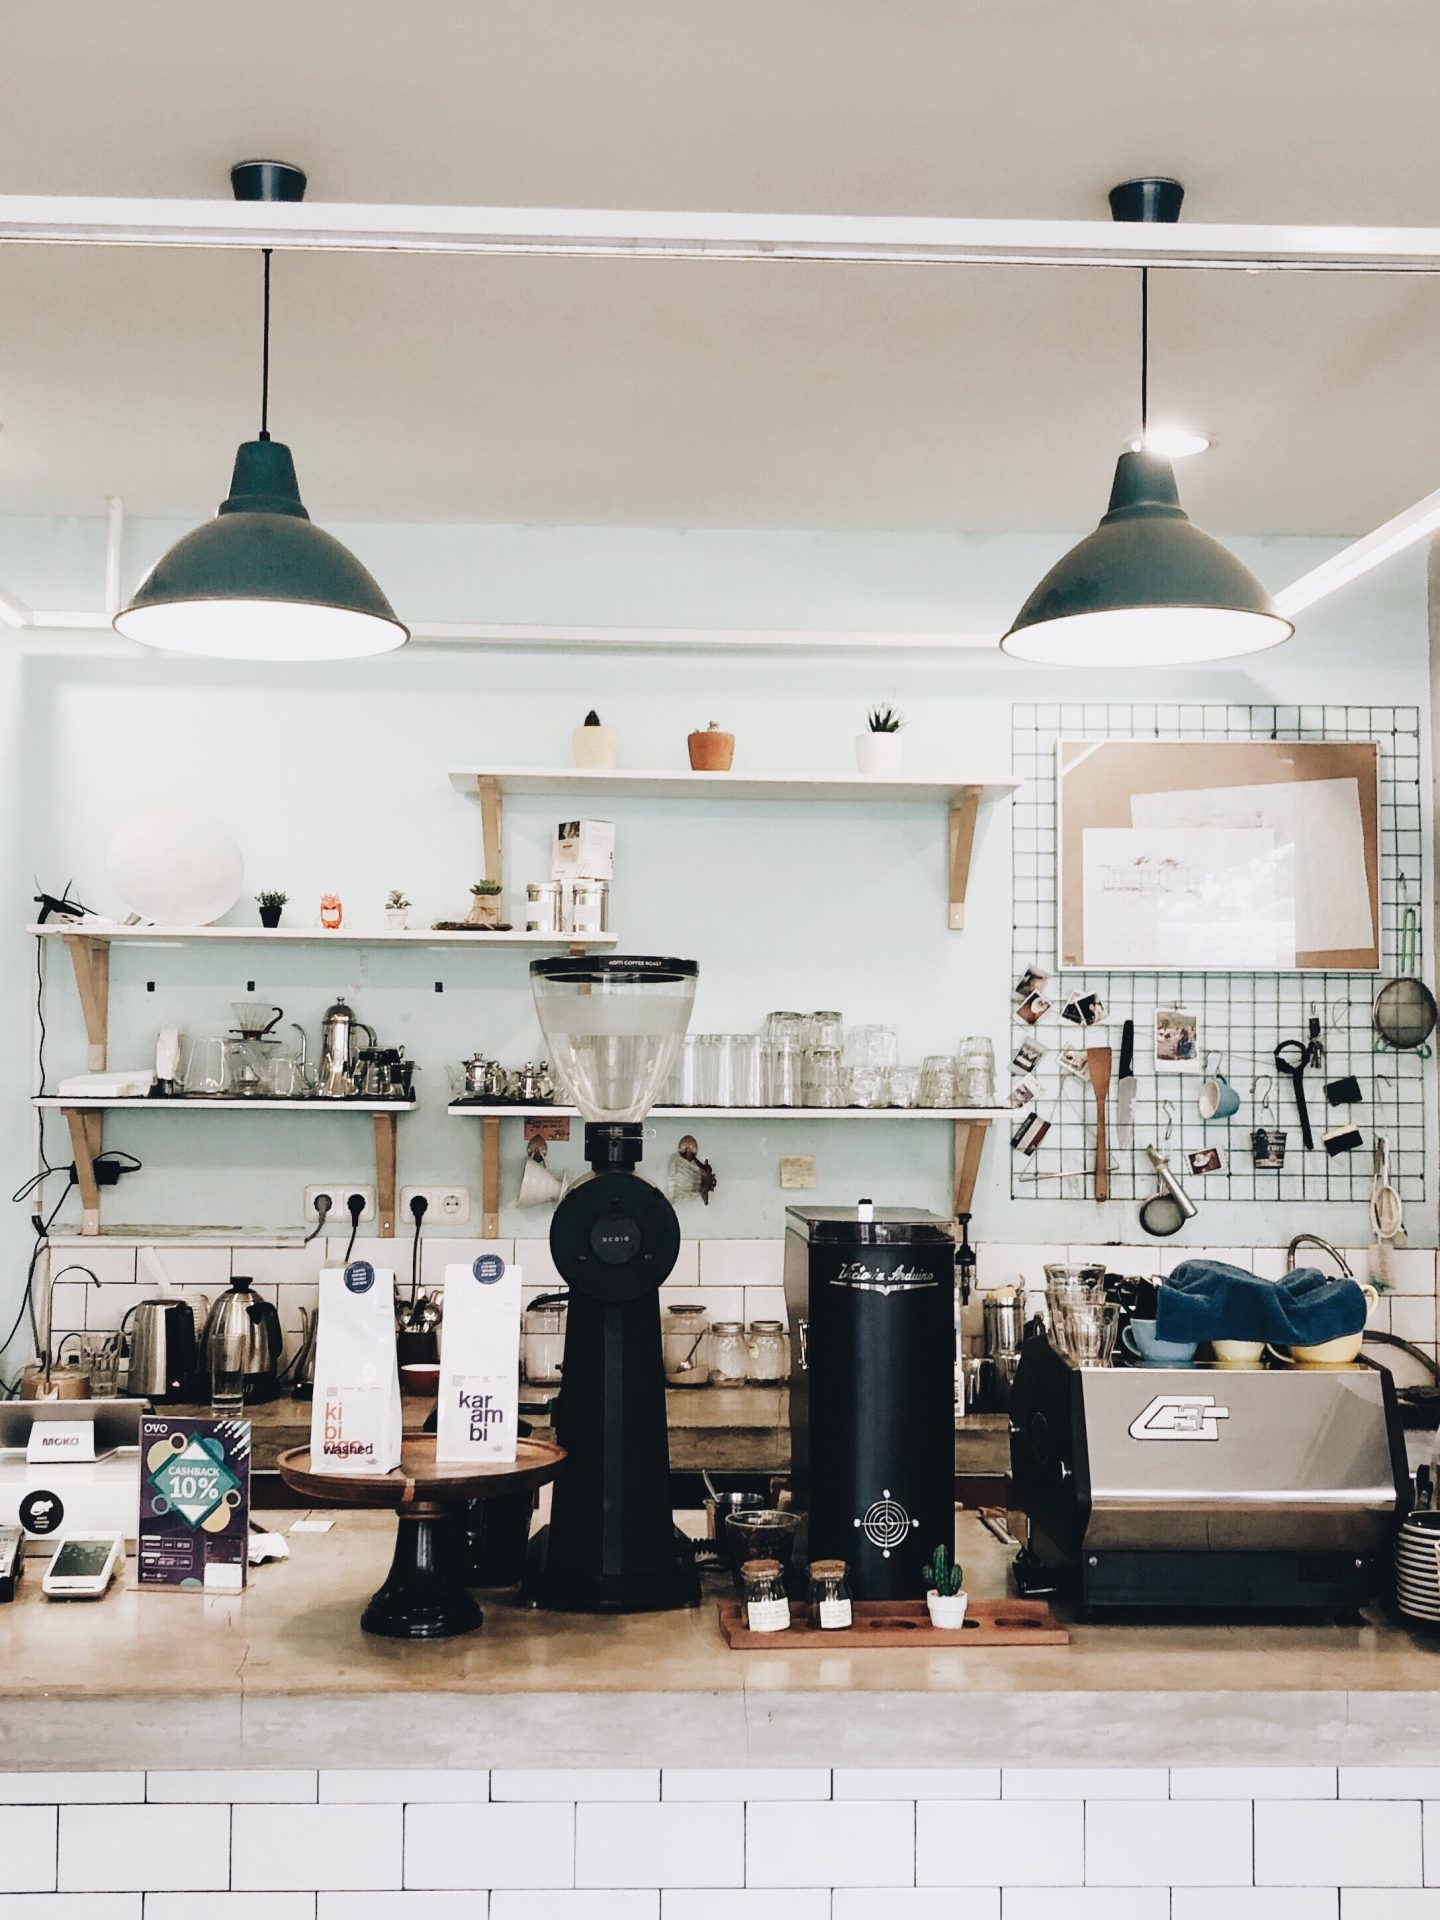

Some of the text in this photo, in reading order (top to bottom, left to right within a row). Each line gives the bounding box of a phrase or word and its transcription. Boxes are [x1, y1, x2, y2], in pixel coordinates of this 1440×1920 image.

[887, 1263, 934, 1281] Arduino
[459, 1390, 493, 1408] kar
[324, 1402, 342, 1421] ki
[470, 1409, 504, 1423] am
[143, 1423, 169, 1434] OVO
[324, 1421, 342, 1440] bi
[469, 1423, 488, 1441] bi
[168, 1466, 220, 1477] CASHBACK
[169, 1476, 219, 1499] 10%
